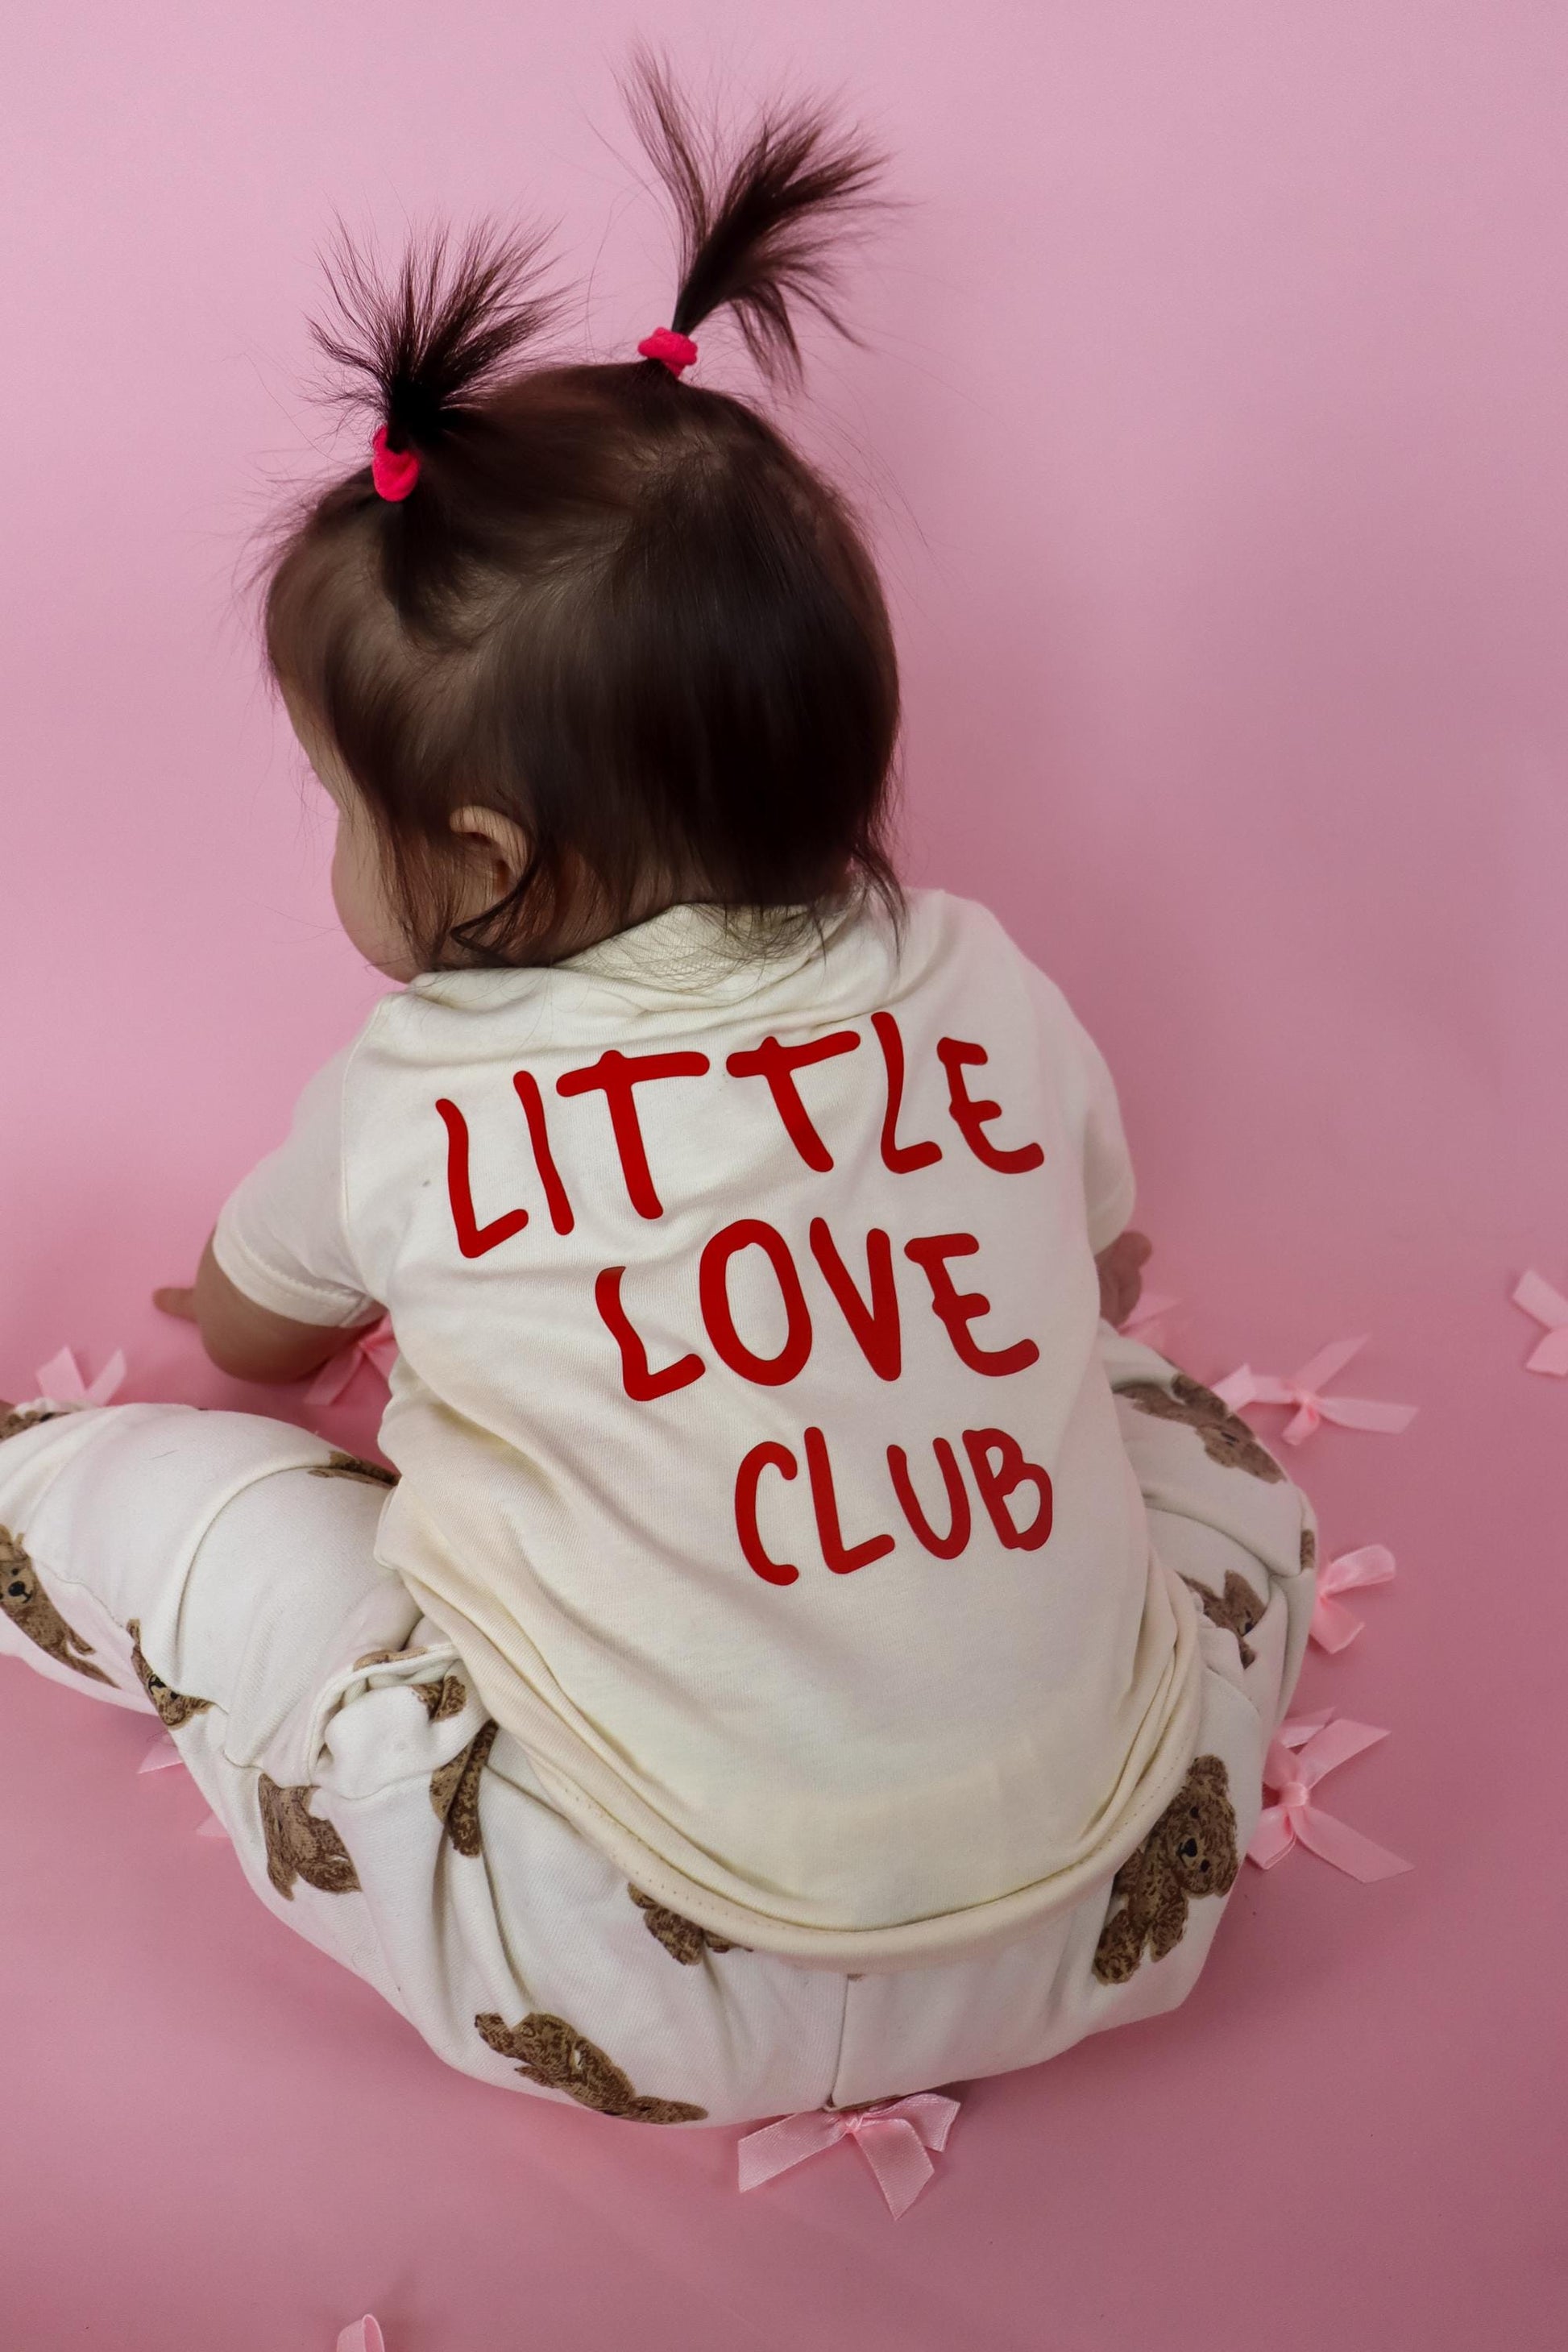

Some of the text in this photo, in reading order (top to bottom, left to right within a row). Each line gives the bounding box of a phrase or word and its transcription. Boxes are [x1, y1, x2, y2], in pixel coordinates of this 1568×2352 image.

[435, 1010, 1045, 1259] LITTLE
[594, 1216, 1040, 1403] LOVE
[733, 1425, 1054, 1587] CLUB
